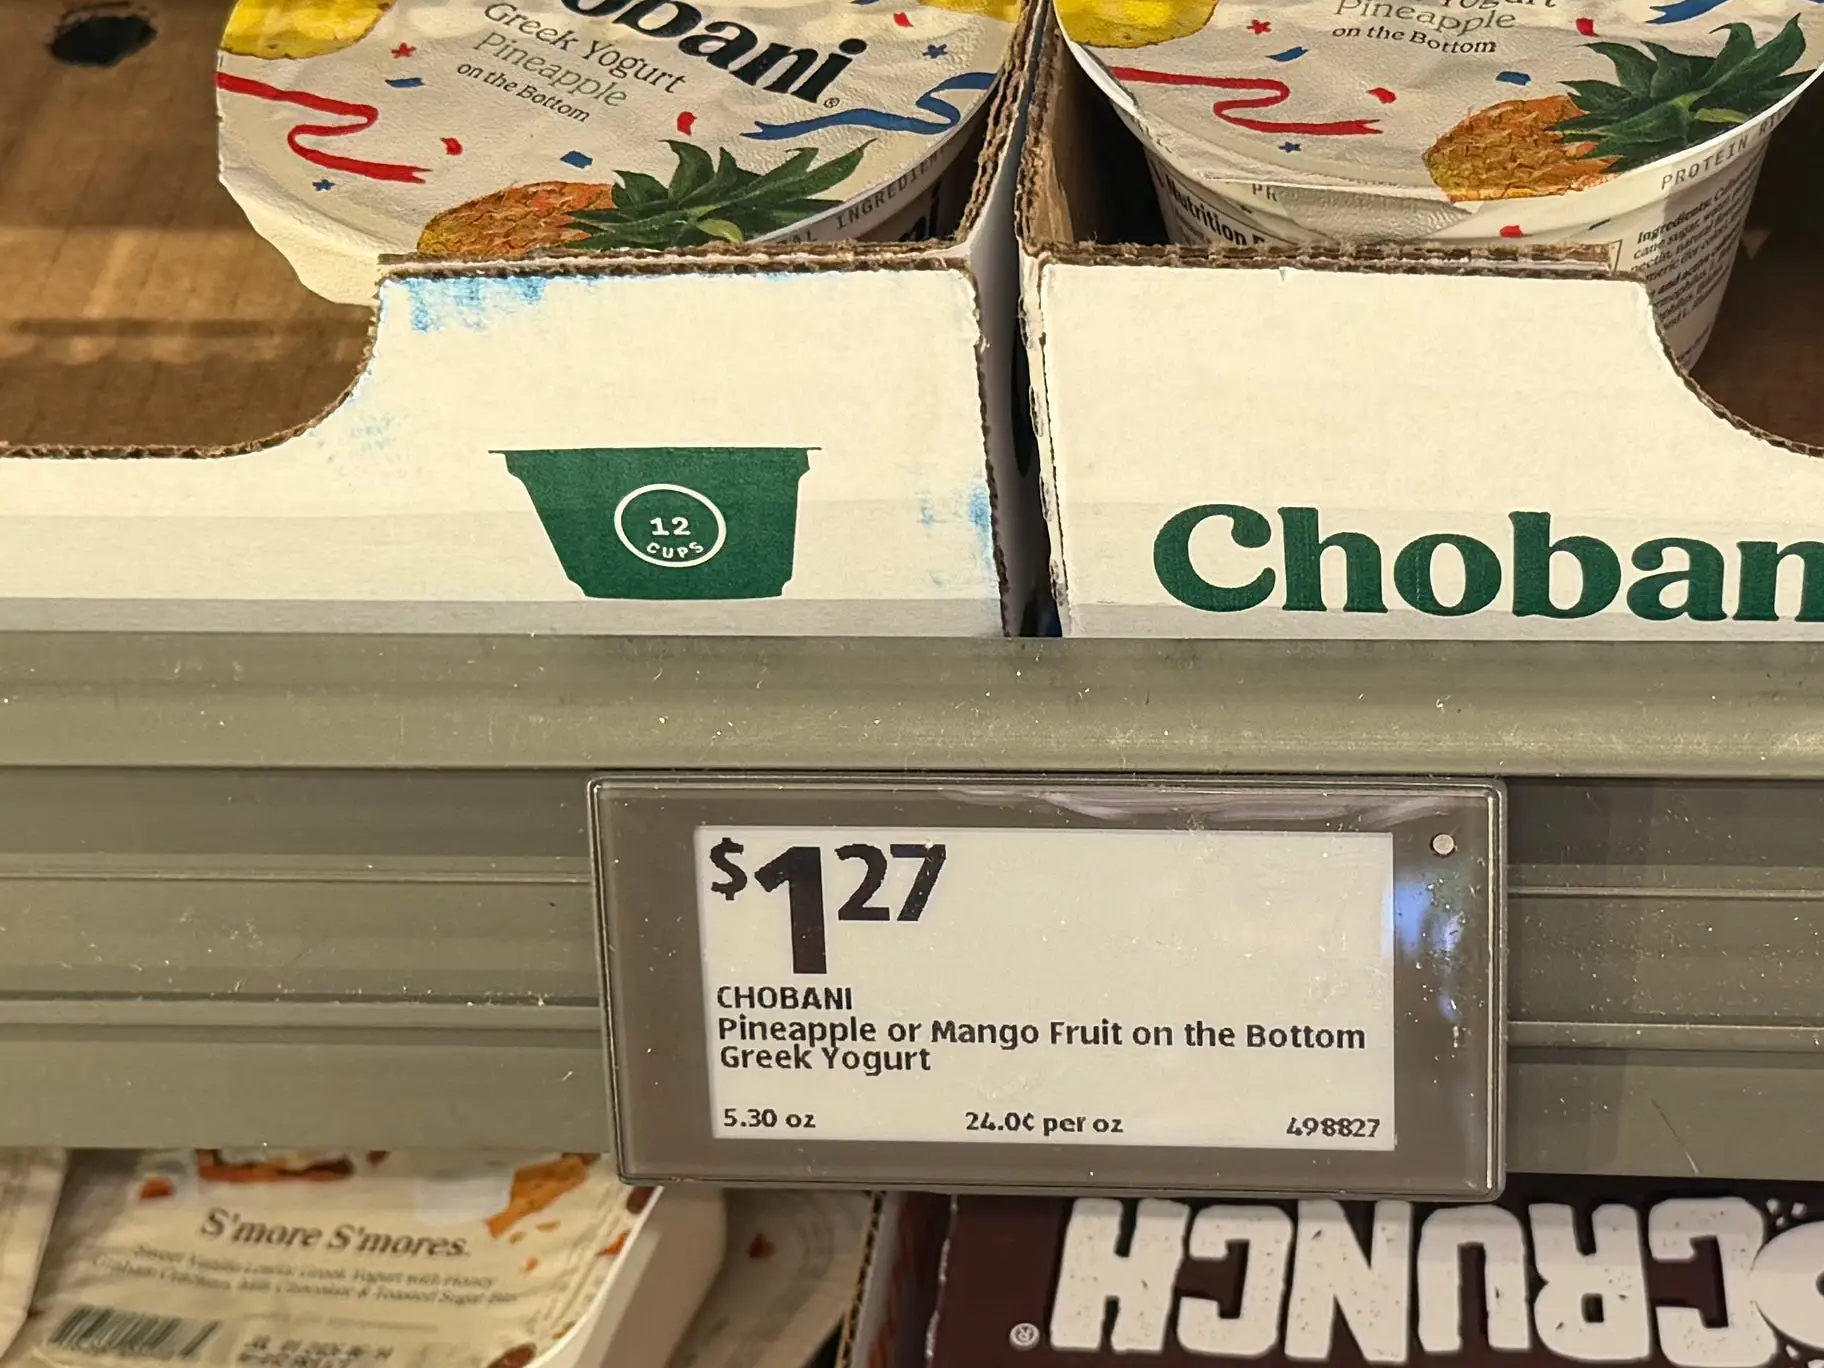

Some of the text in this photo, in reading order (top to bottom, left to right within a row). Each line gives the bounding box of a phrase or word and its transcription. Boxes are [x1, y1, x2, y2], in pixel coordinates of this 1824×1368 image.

[484, 2, 685, 98] Greek Yogurt
[1332, 24, 1498, 55] on the Bottom
[474, 33, 628, 109] Pineapple
[457, 62, 590, 123] on the Bottom
[1661, 135, 1748, 190] PROTEIN
[1165, 173, 1247, 246] Nutrition
[650, 517, 690, 536] 12
[646, 541, 703, 558] CUPS
[717, 987, 853, 1011] CHOBANI
[719, 1016, 1366, 1051] Pineapple or Mango Fruit on the Bottom
[719, 1045, 932, 1076] Greek Yogurt
[723, 1107, 1380, 1139] 5.30 oz 24.0¢ per oz 498827
[200, 1207, 324, 1248] S'more
